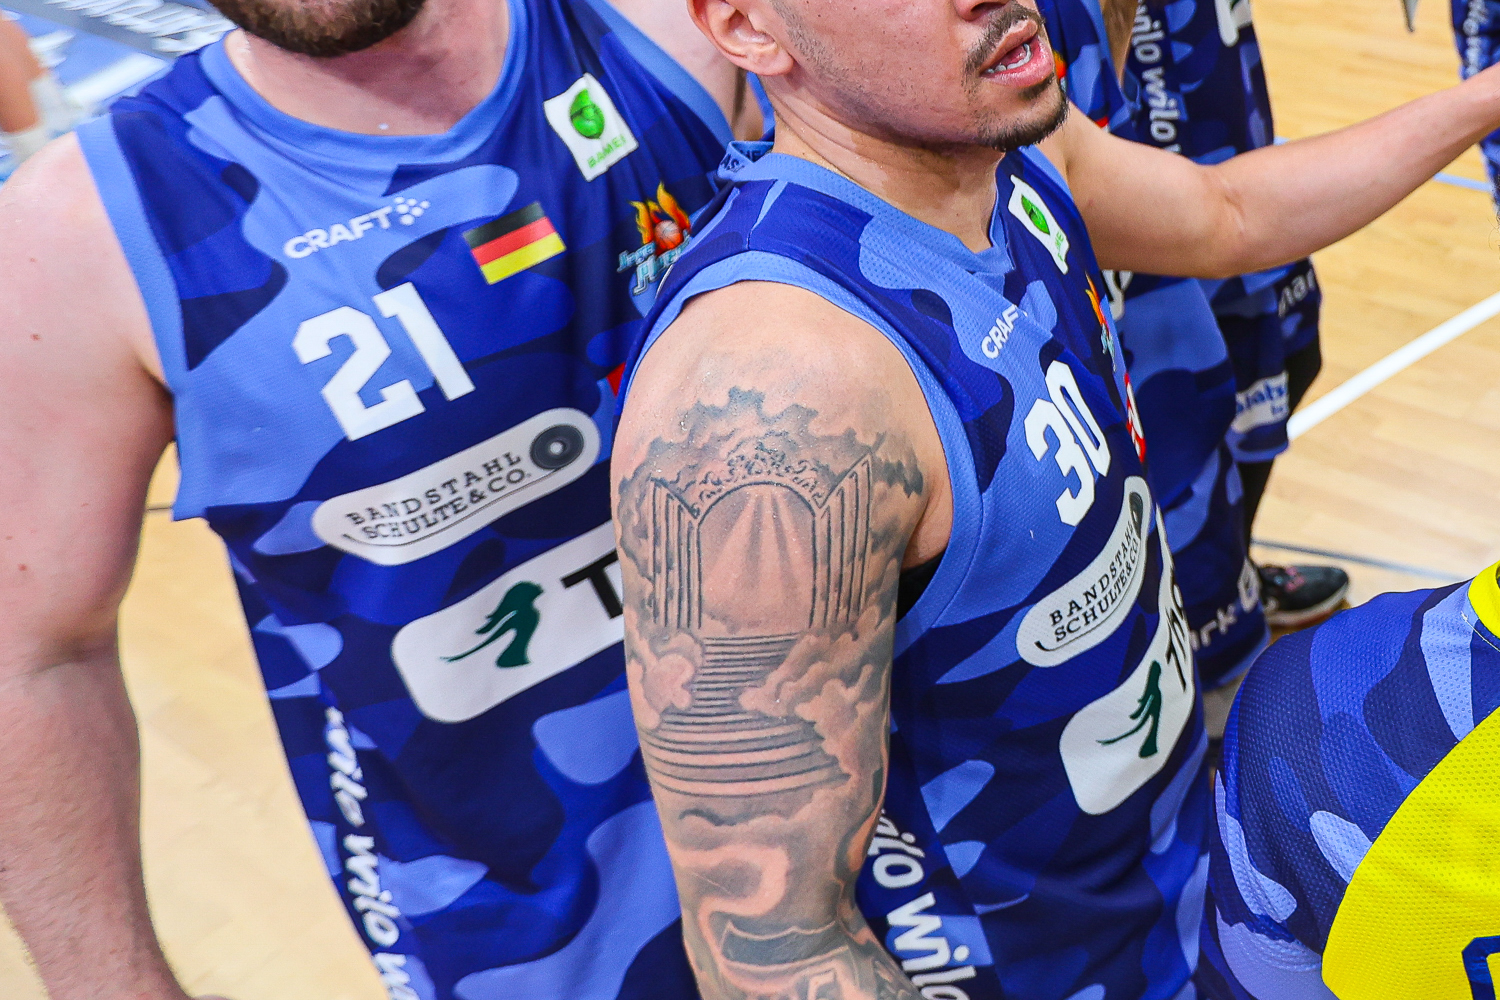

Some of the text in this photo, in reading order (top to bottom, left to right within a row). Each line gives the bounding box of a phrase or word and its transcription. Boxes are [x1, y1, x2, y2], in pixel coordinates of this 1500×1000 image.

[1142, 66, 1181, 143] wilo
[284, 208, 394, 259] CRAFT
[291, 281, 476, 442] 21
[344, 451, 522, 526] BANDSTAHL
[1023, 359, 1111, 527] 30
[343, 833, 401, 948] wilo
